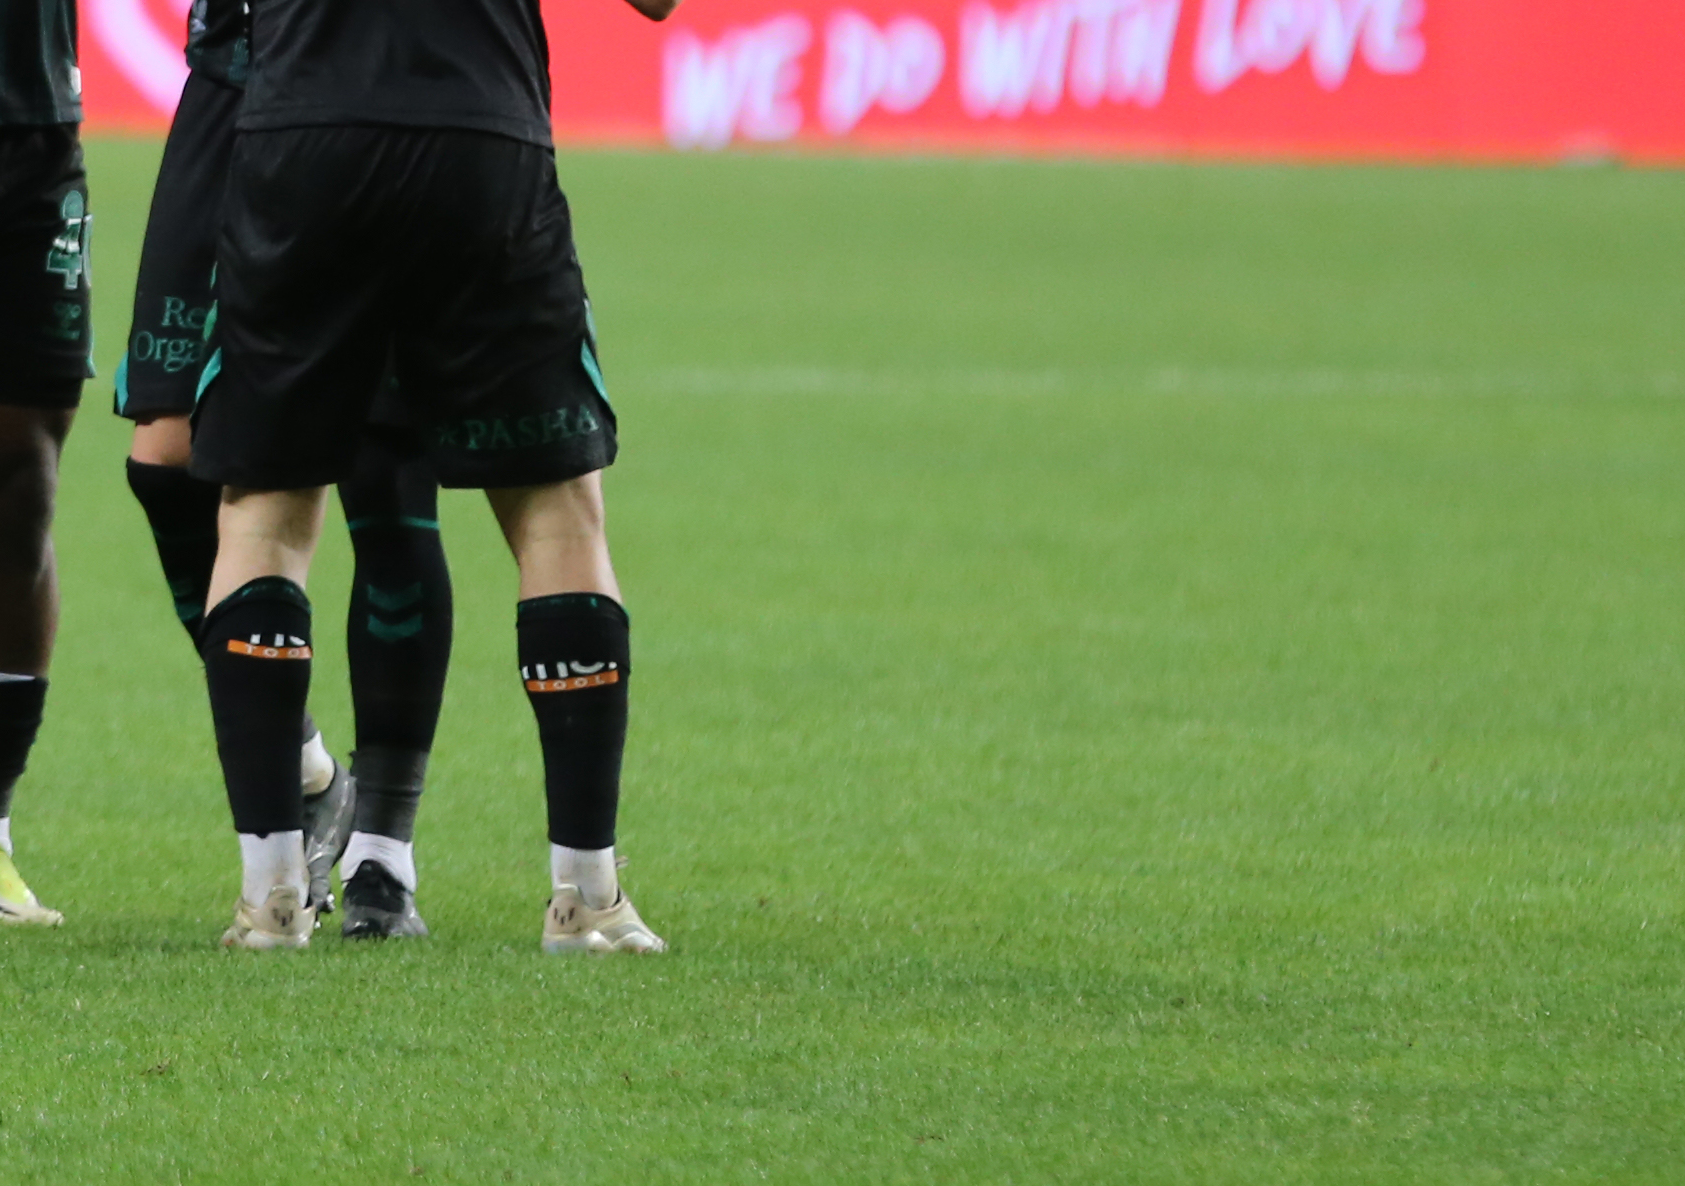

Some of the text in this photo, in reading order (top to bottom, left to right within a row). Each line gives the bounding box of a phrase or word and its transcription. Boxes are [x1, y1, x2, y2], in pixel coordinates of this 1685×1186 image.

[661, 13, 812, 150] WE
[820, 8, 945, 134] DO
[536, 675, 606, 691] TOOL
